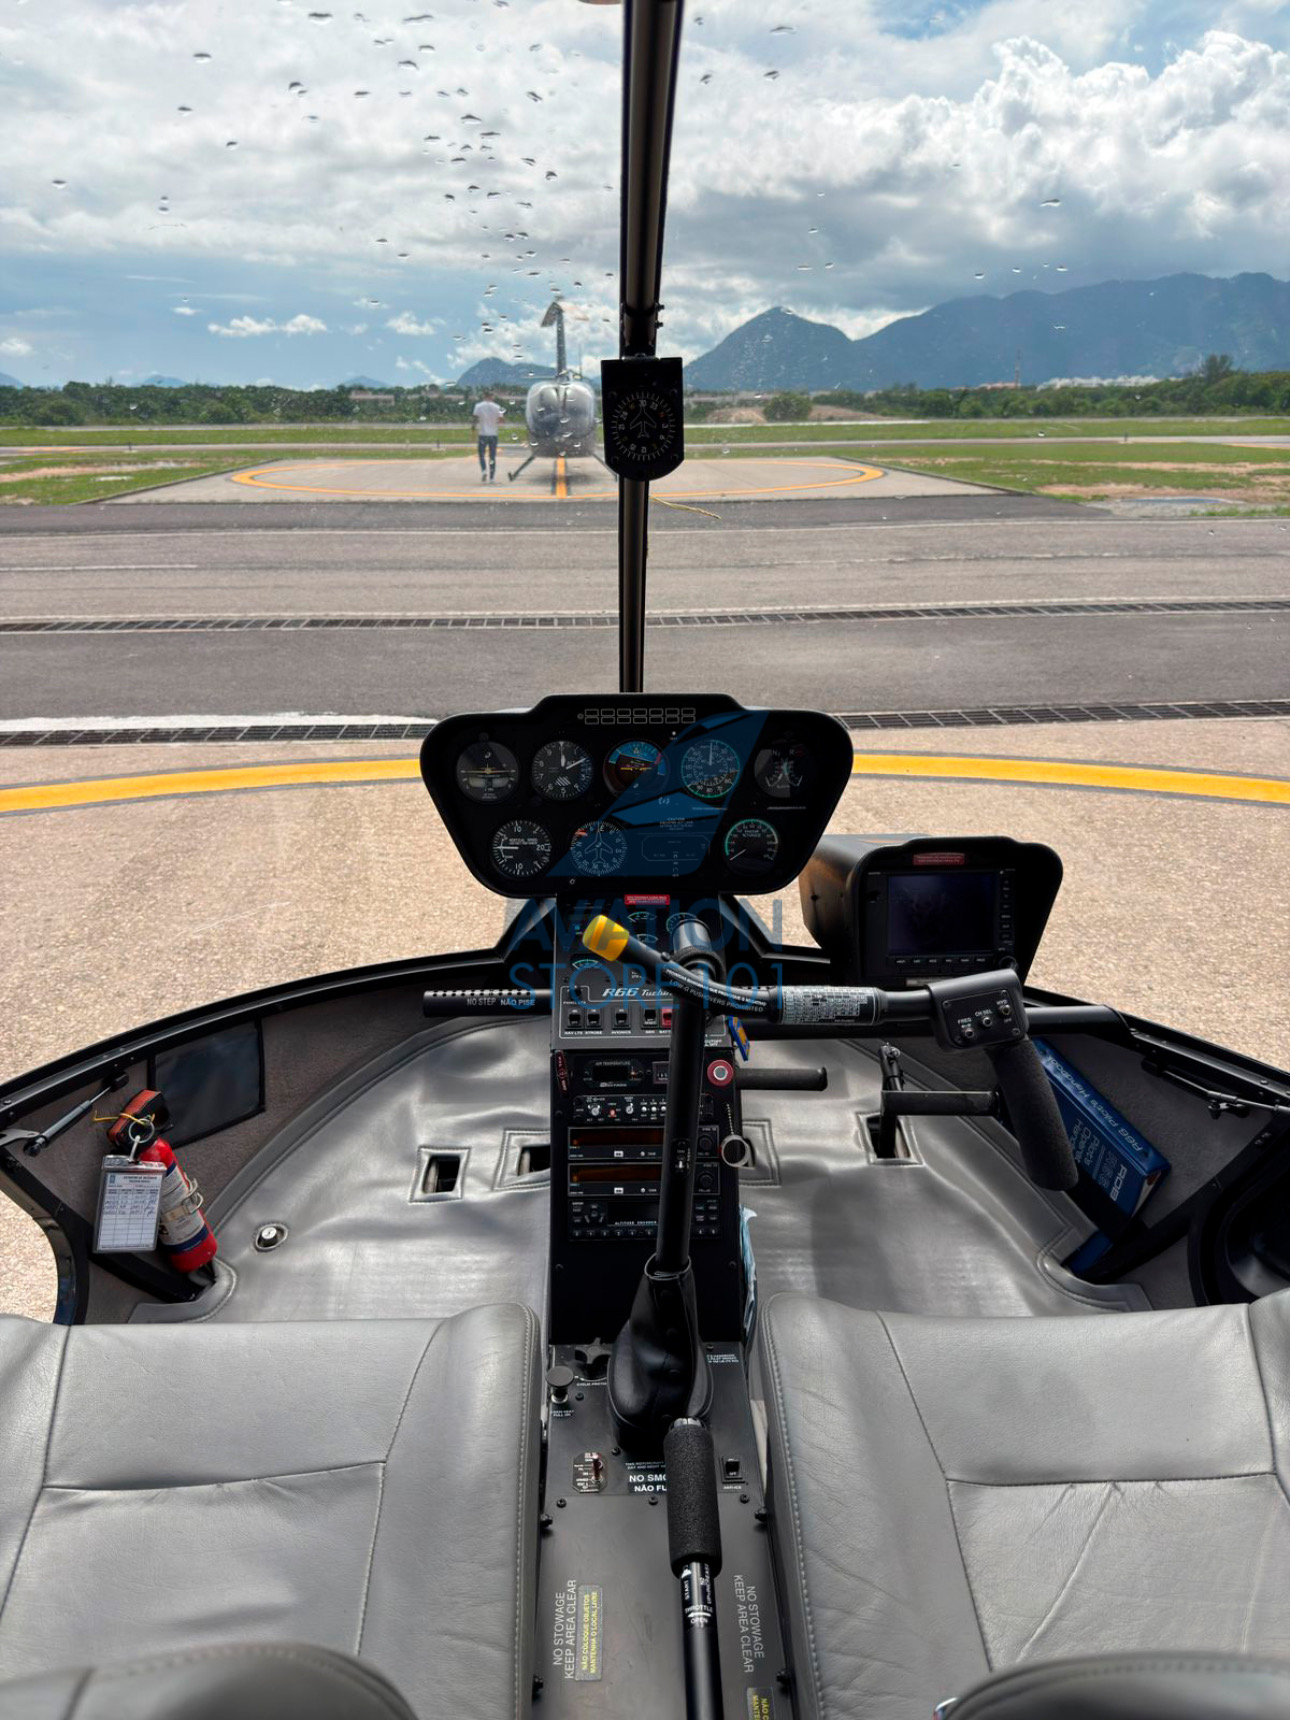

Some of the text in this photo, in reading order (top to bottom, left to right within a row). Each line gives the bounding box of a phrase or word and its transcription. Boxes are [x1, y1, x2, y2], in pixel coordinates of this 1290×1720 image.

[466, 997, 496, 1006] NO STEP
[602, 987, 640, 997] R66
[1109, 1164, 1128, 1202] ROB
[629, 1474, 644, 1482] NO
[634, 1483, 654, 1492] NÃO
[553, 1592, 566, 1665] NO STOWAGE
[564, 1579, 576, 1679] KEEP AREA CLEAR
[733, 1574, 754, 1673] KEEP AREA CLEAR
[746, 1585, 765, 1659] NO STOWAGE
[752, 1694, 761, 1720] MANTE
